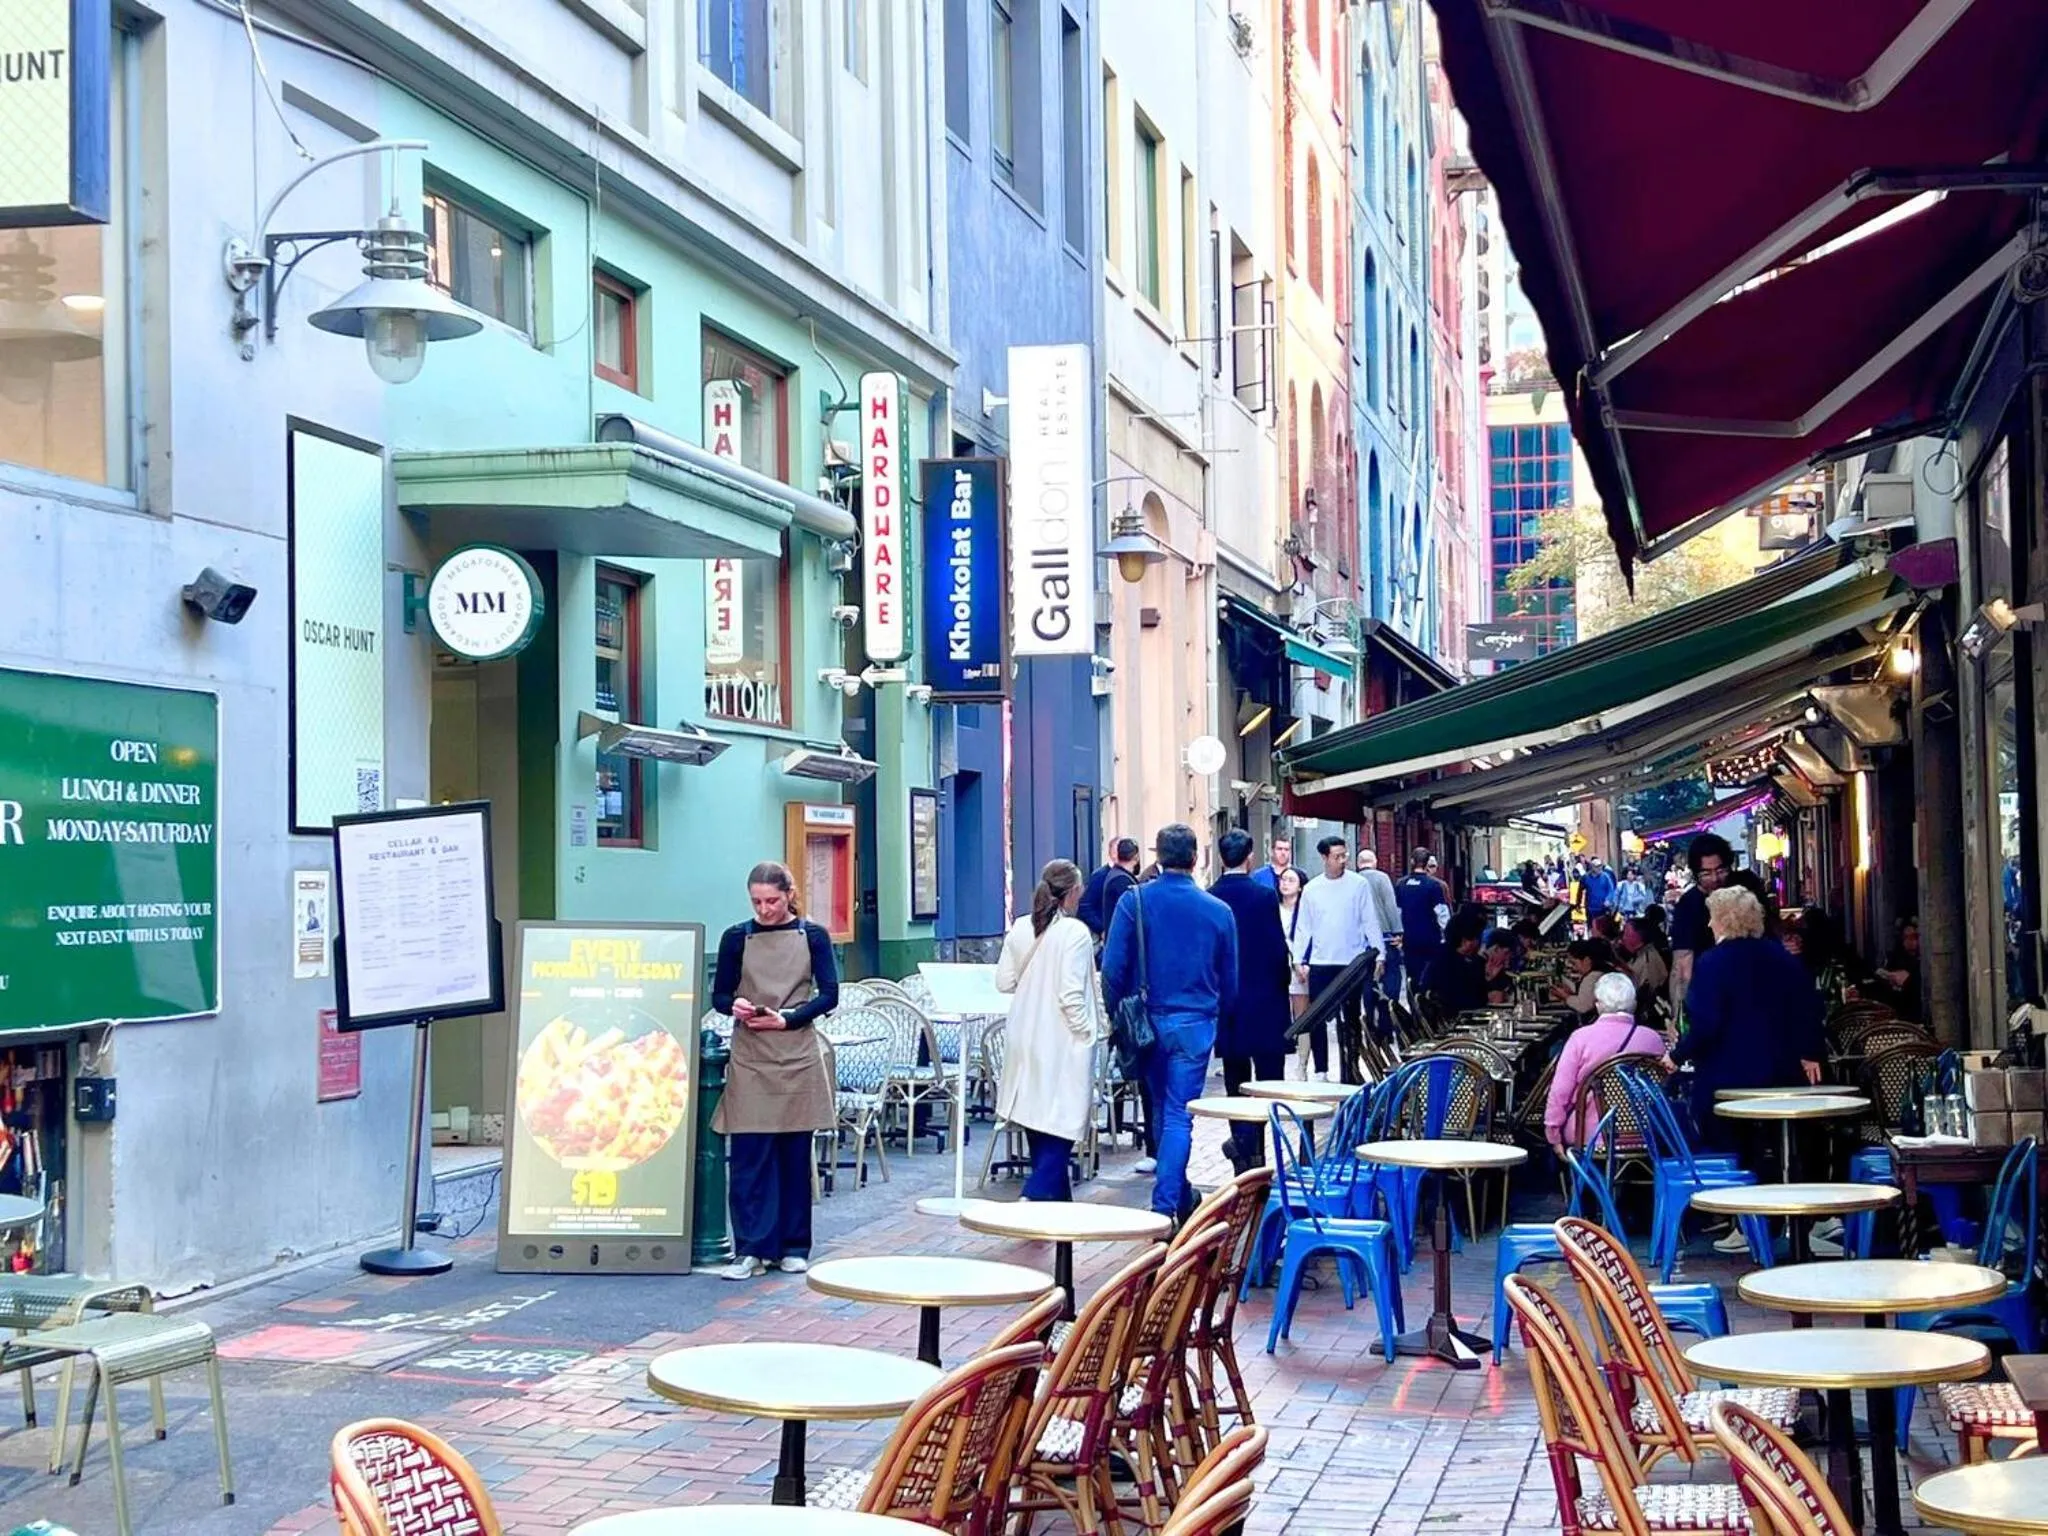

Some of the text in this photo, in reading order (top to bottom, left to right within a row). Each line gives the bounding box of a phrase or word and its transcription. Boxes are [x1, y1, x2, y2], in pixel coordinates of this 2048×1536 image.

[0, 50, 64, 82] UNT
[1039, 382, 1049, 436] REAL
[1056, 357, 1067, 436] ESTATE
[872, 396, 892, 625] HARDWARE
[949, 469, 972, 660] Khokolat Bar
[455, 591, 505, 614] MM
[303, 618, 375, 653] OSCAR HUNT
[110, 739, 157, 764] OPEN
[61, 777, 200, 805] LUNCH & DINNER
[47, 819, 212, 844] MONDAY-SATURDAY
[387, 837, 422, 849] CELLAR
[368, 848, 425, 861] RESTAURANT
[442, 845, 459, 854] BAR
[47, 902, 211, 923] ENQUIRE ABOUT HOSTING YOUR
[56, 926, 205, 946] NEXT EVENT WITH US TODAY
[569, 939, 642, 965] EVERY
[613, 961, 684, 981] TUESDAY
